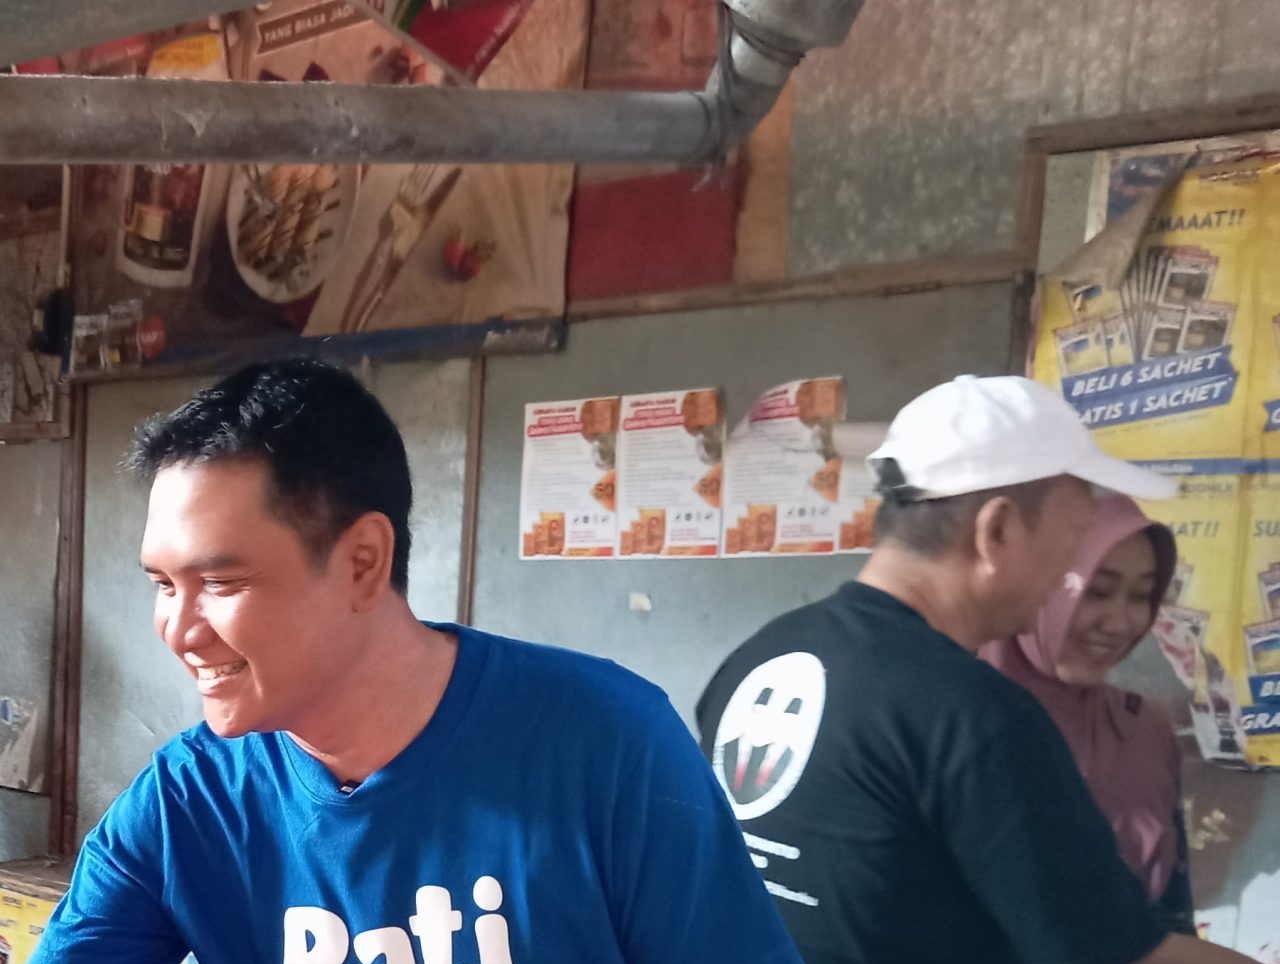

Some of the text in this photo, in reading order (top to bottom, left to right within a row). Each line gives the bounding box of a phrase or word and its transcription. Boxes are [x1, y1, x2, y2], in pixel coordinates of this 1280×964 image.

[295, 12, 326, 34] BIASA
[1072, 352, 1222, 396] BELI 6 SACHET
[1078, 380, 1227, 424] ATIS 1 SACHET
